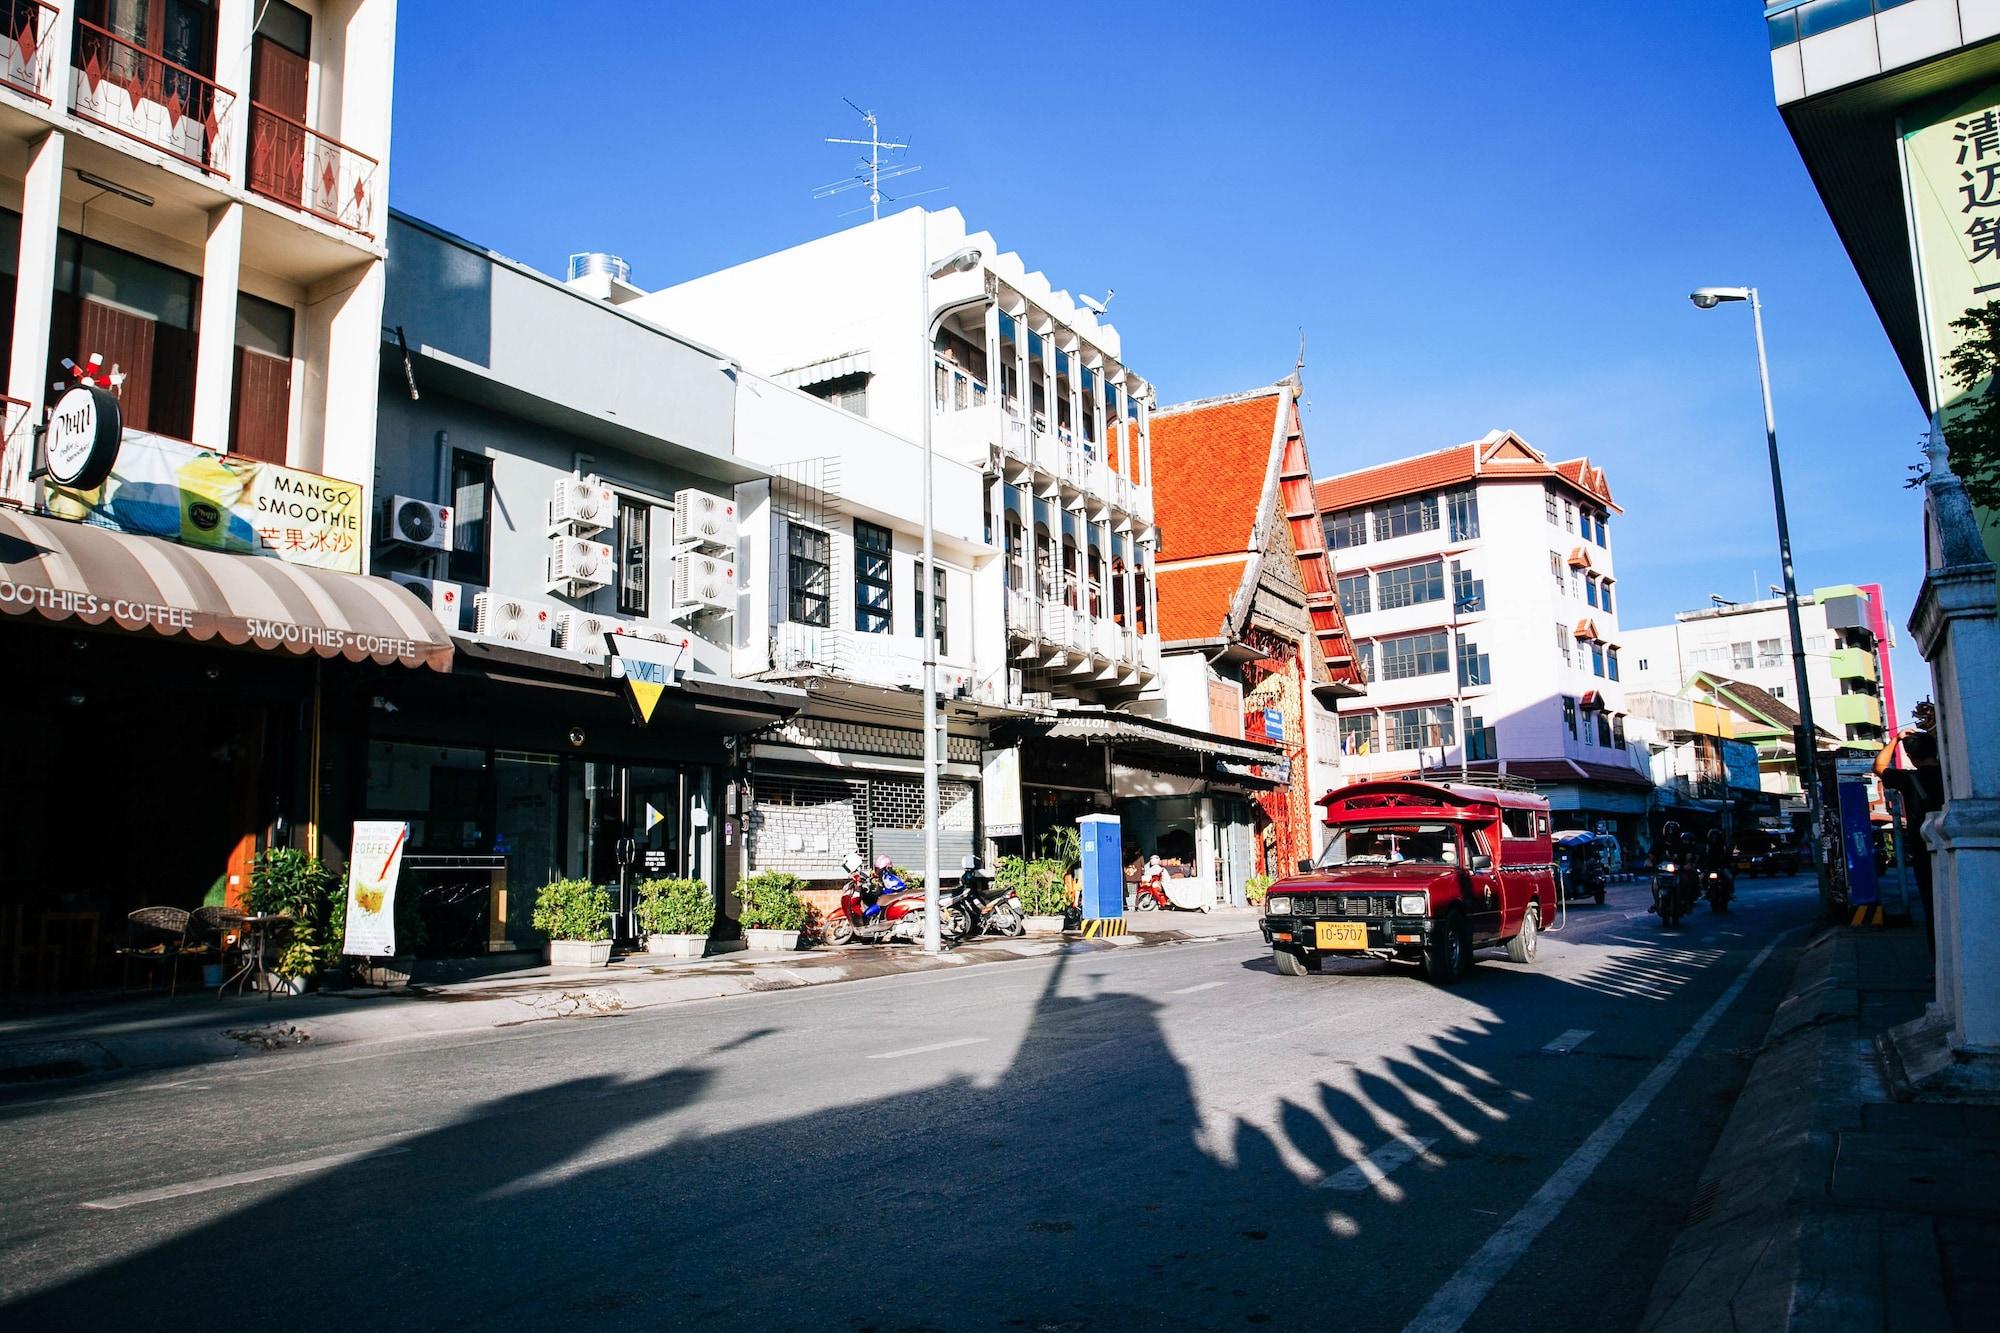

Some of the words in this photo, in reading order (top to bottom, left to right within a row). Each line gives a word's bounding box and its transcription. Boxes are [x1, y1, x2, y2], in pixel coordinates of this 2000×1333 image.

[274, 476, 351, 506] MANGO
[258, 496, 357, 530] SMOOTHIE
[257, 526, 353, 553] 芒果冰沙
[114, 599, 194, 629] COFFEE
[246, 618, 344, 649] SMOOTHIES
[356, 634, 416, 658] COFFEE
[355, 842, 390, 854] COFFEE
[1321, 928, 1363, 941] 10-5707
